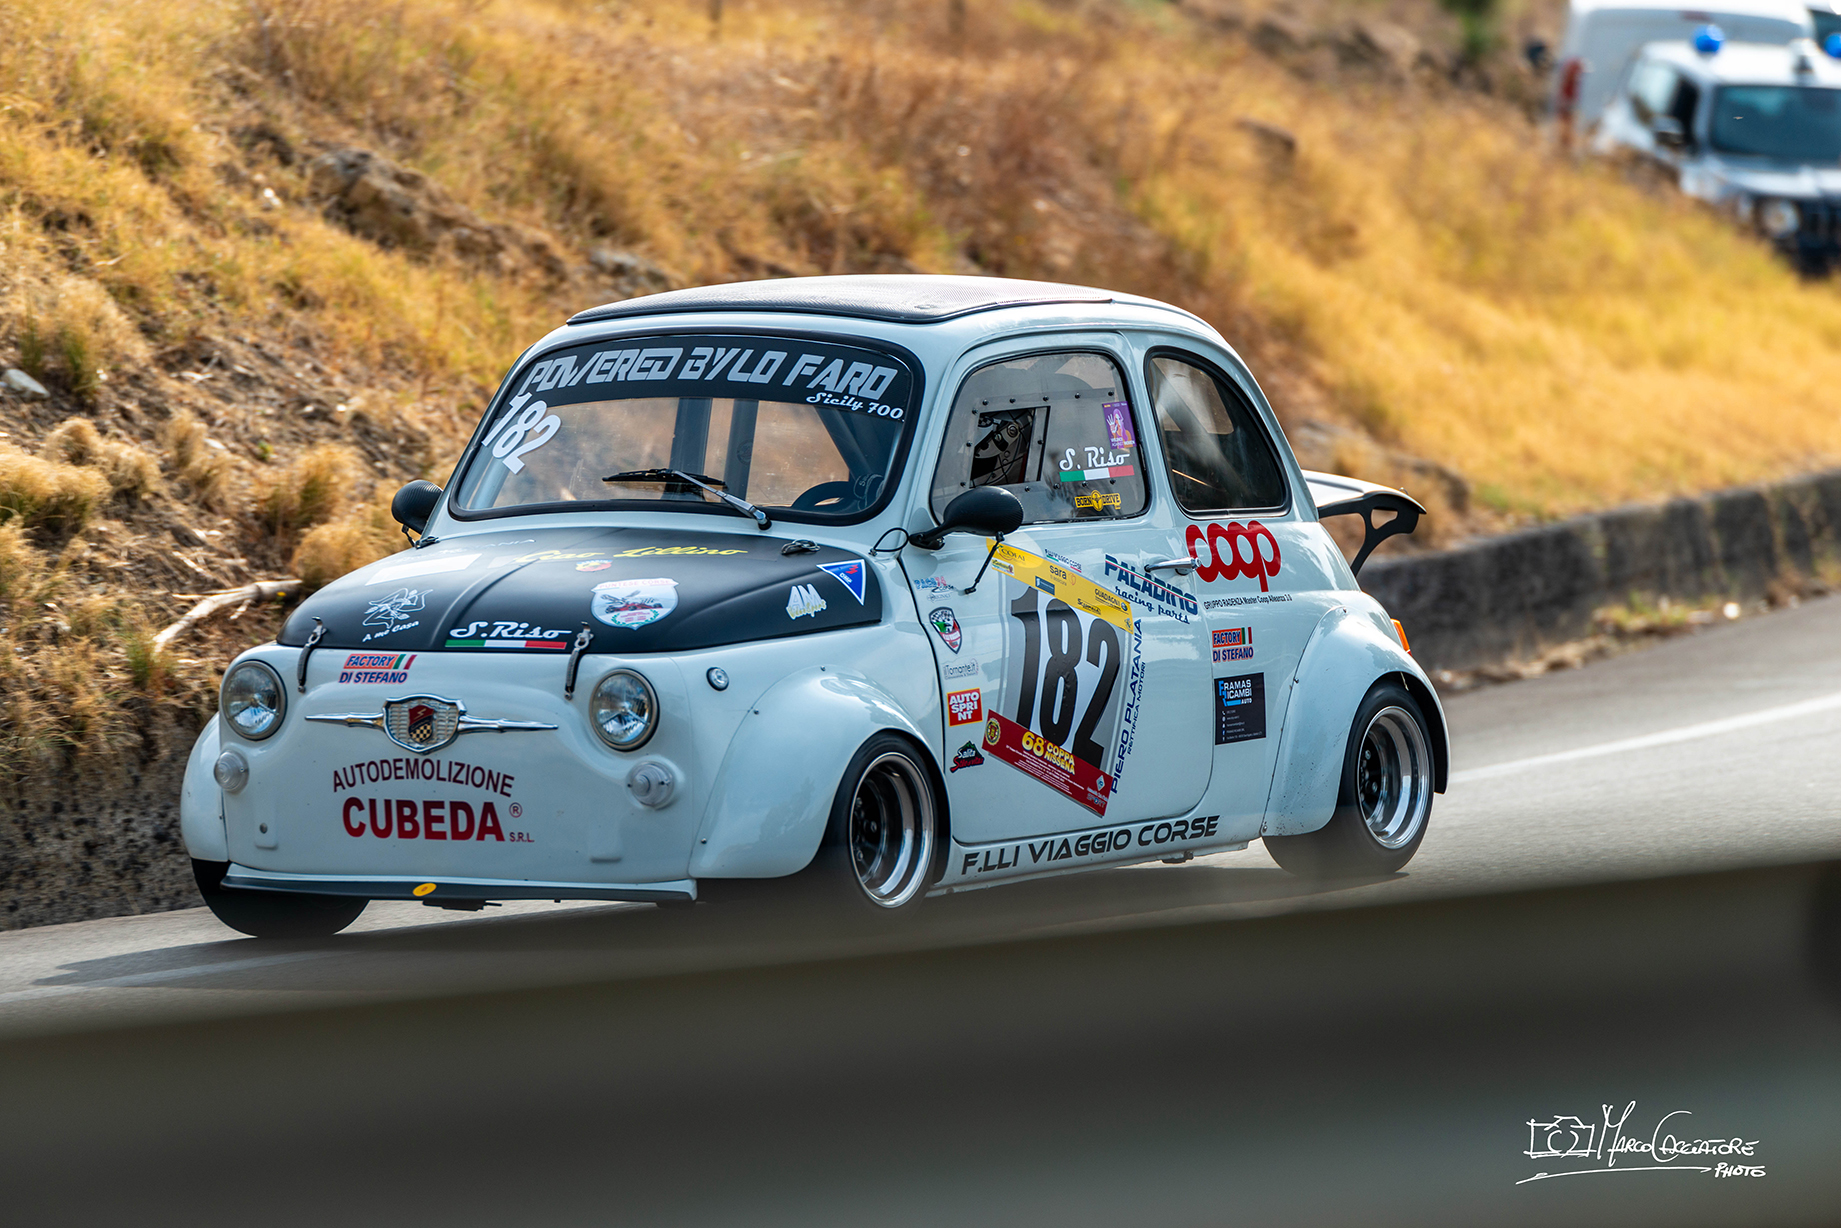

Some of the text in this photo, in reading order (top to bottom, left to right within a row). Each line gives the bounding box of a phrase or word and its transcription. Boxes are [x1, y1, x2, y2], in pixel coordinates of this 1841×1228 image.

[517, 348, 683, 396] POWERED
[782, 353, 898, 400] FARO
[806, 392, 904, 420] Sicily 700
[481, 391, 562, 475] 182
[1084, 446, 1131, 468] Riso
[1185, 520, 1282, 593] coop
[1049, 564, 1067, 580] sara
[1115, 585, 1155, 612] racing
[1158, 604, 1190, 625] parts
[1212, 630, 1241, 645] FACTORY
[346, 655, 396, 667] FACTORY
[1212, 645, 1254, 662] DI STEFANO
[338, 671, 409, 684] DI STEFANO
[1010, 586, 1121, 770] 182
[949, 691, 980, 706] AUTO
[951, 700, 978, 714] SPRI
[1110, 729, 1130, 795] PIERO
[1124, 618, 1142, 724] PLATANIA
[958, 710, 973, 721] NT
[1044, 751, 1076, 775] NISSENA
[1046, 742, 1075, 766] COPPA
[333, 758, 515, 798] AUTODEMOLIZIONE
[342, 796, 506, 842] CUBEDA
[509, 831, 535, 843] S.R.L.
[1028, 829, 1132, 864] VIAGGIO
[1137, 815, 1220, 847] CORSE
